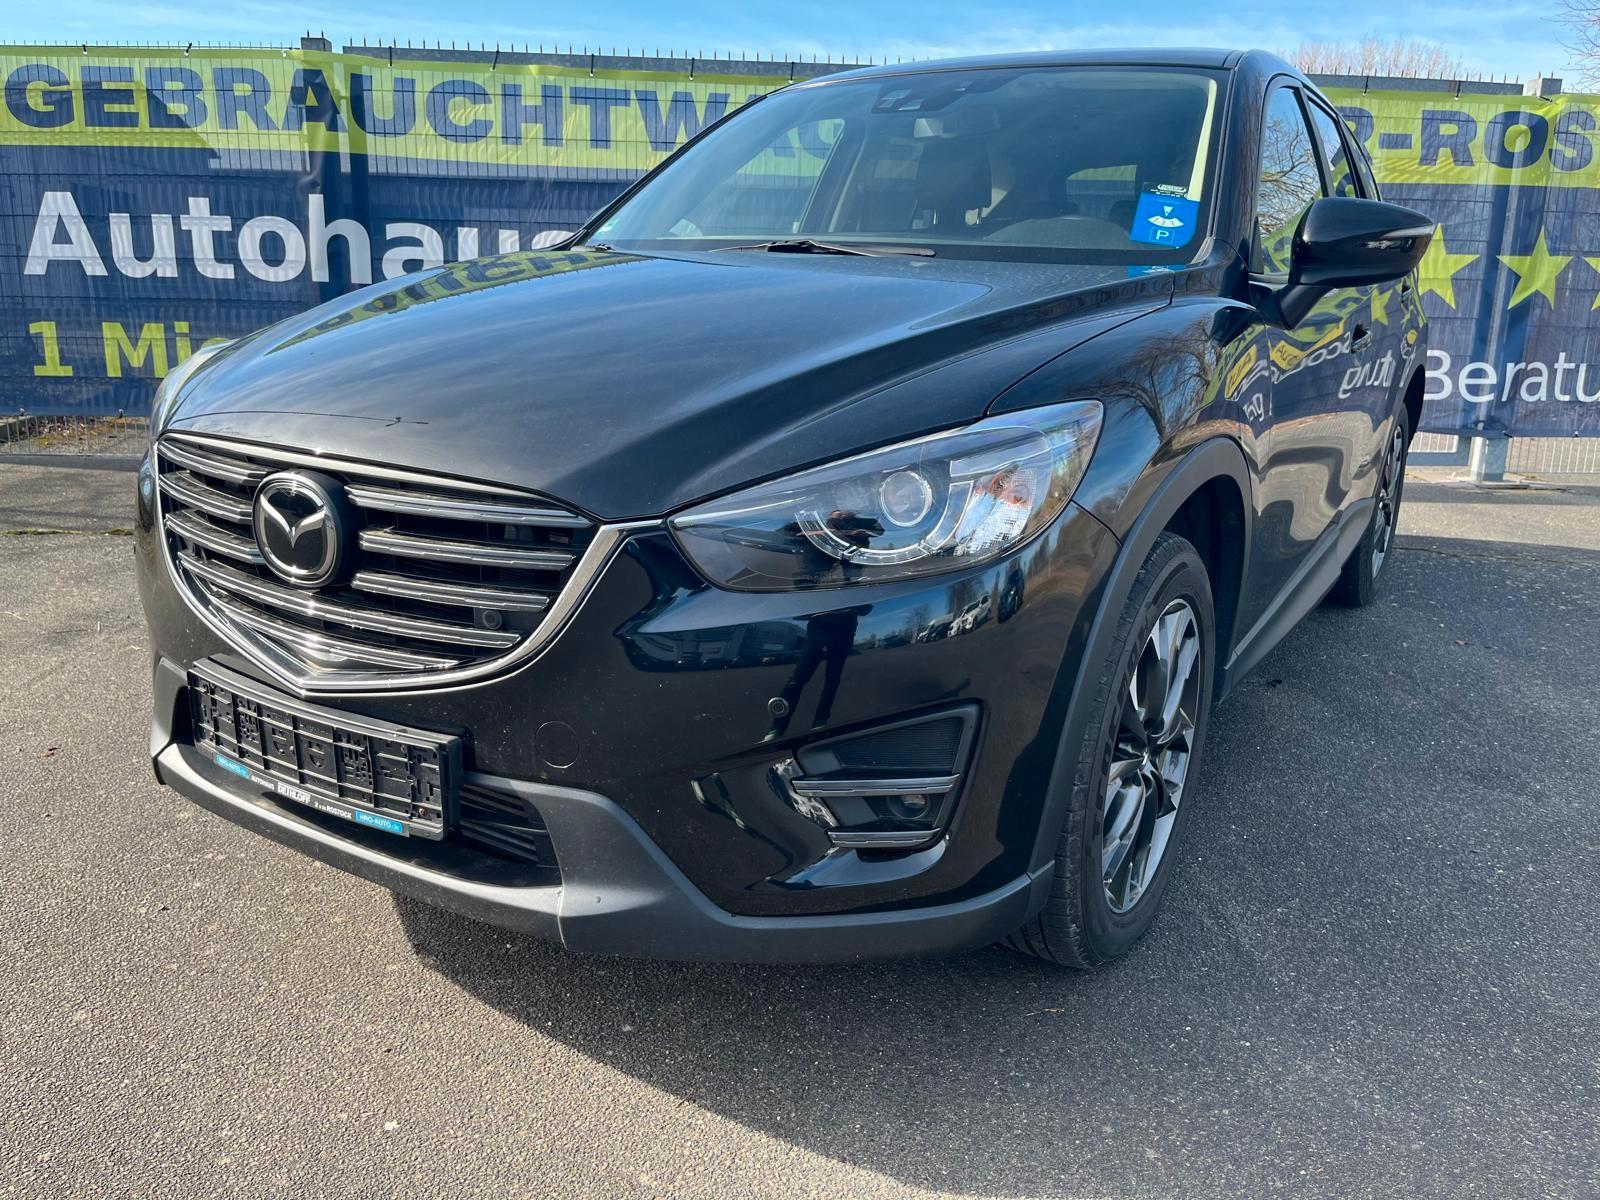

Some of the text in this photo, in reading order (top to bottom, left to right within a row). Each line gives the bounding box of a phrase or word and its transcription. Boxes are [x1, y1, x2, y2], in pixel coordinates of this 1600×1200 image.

[4, 63, 770, 153] GEBRAUCHTW
[24, 191, 577, 285] Autohau
[1156, 229, 1169, 240] P
[29, 320, 231, 378] 1 Mi
